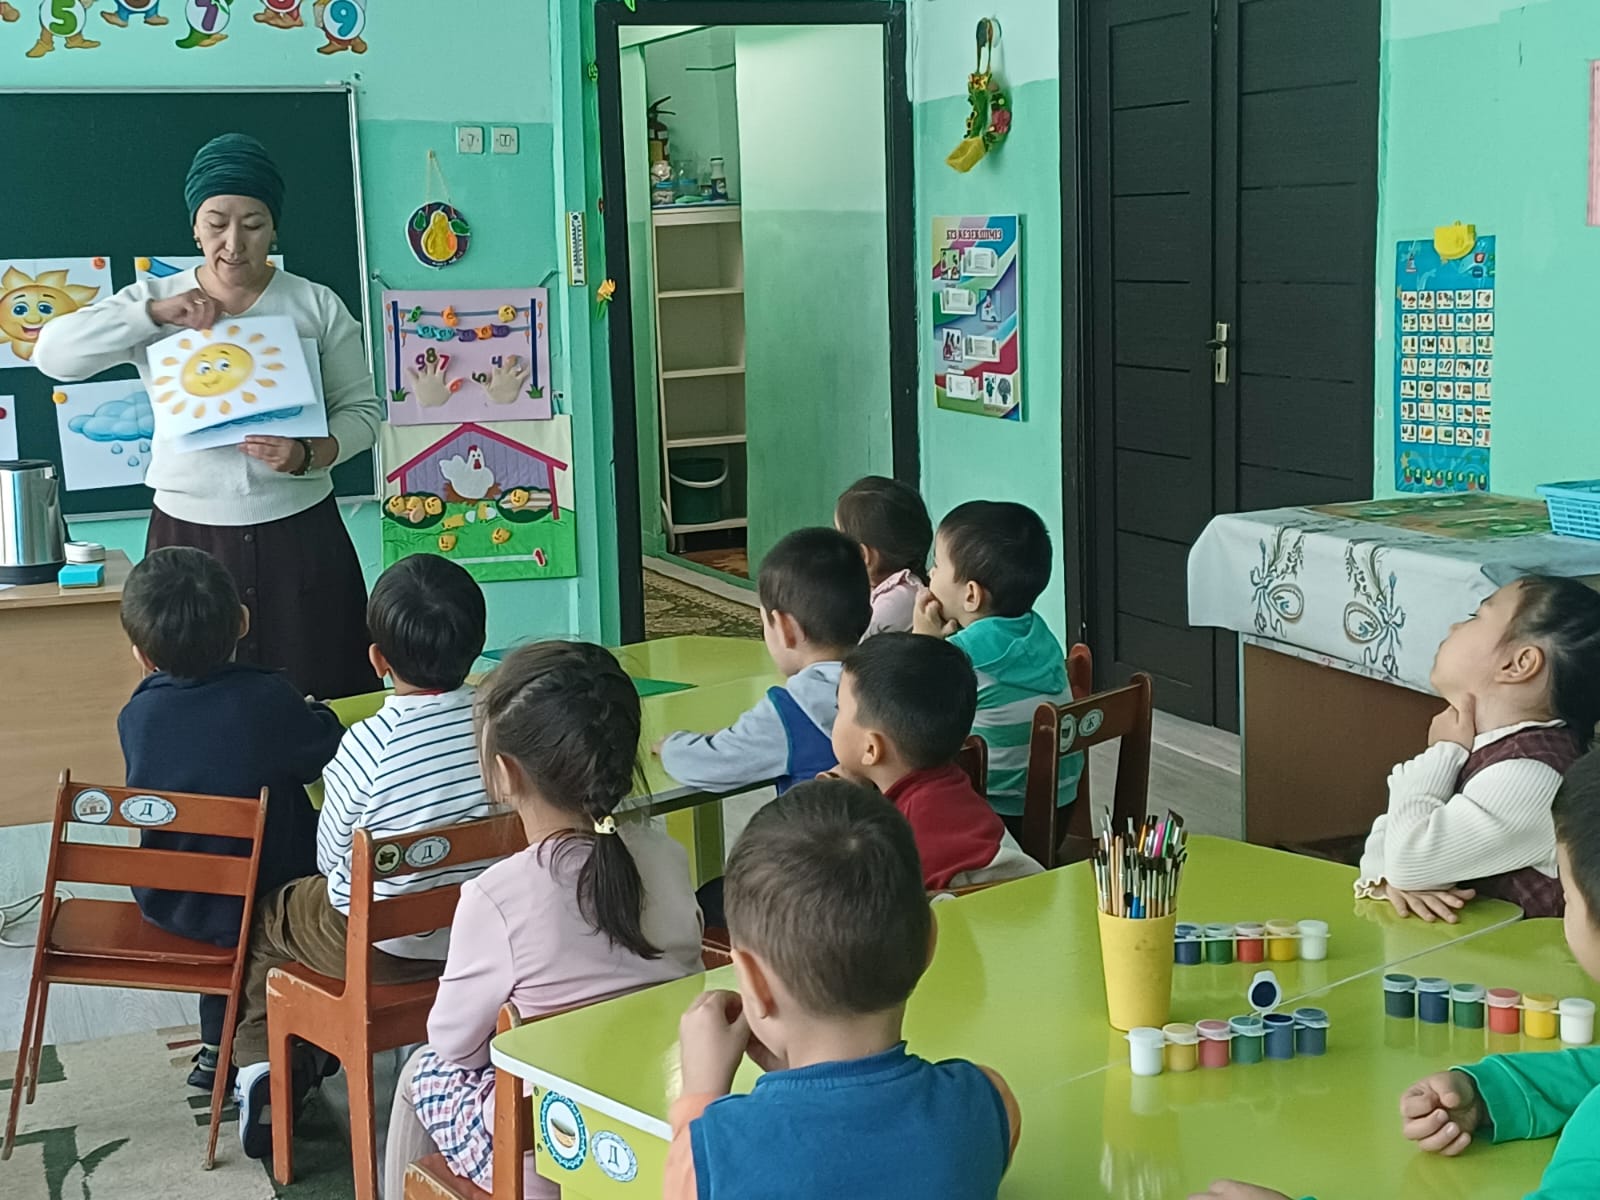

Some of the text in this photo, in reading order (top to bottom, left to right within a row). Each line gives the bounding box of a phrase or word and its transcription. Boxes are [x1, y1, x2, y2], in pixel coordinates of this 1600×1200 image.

[49, 0, 78, 35] 5
[329, 0, 359, 37] 9
[416, 347, 450, 371] 9 8 7
[491, 355, 503, 369] 4
[139, 802, 153, 818] Д
[421, 844, 433, 863] Д
[608, 1144, 620, 1168] Д
